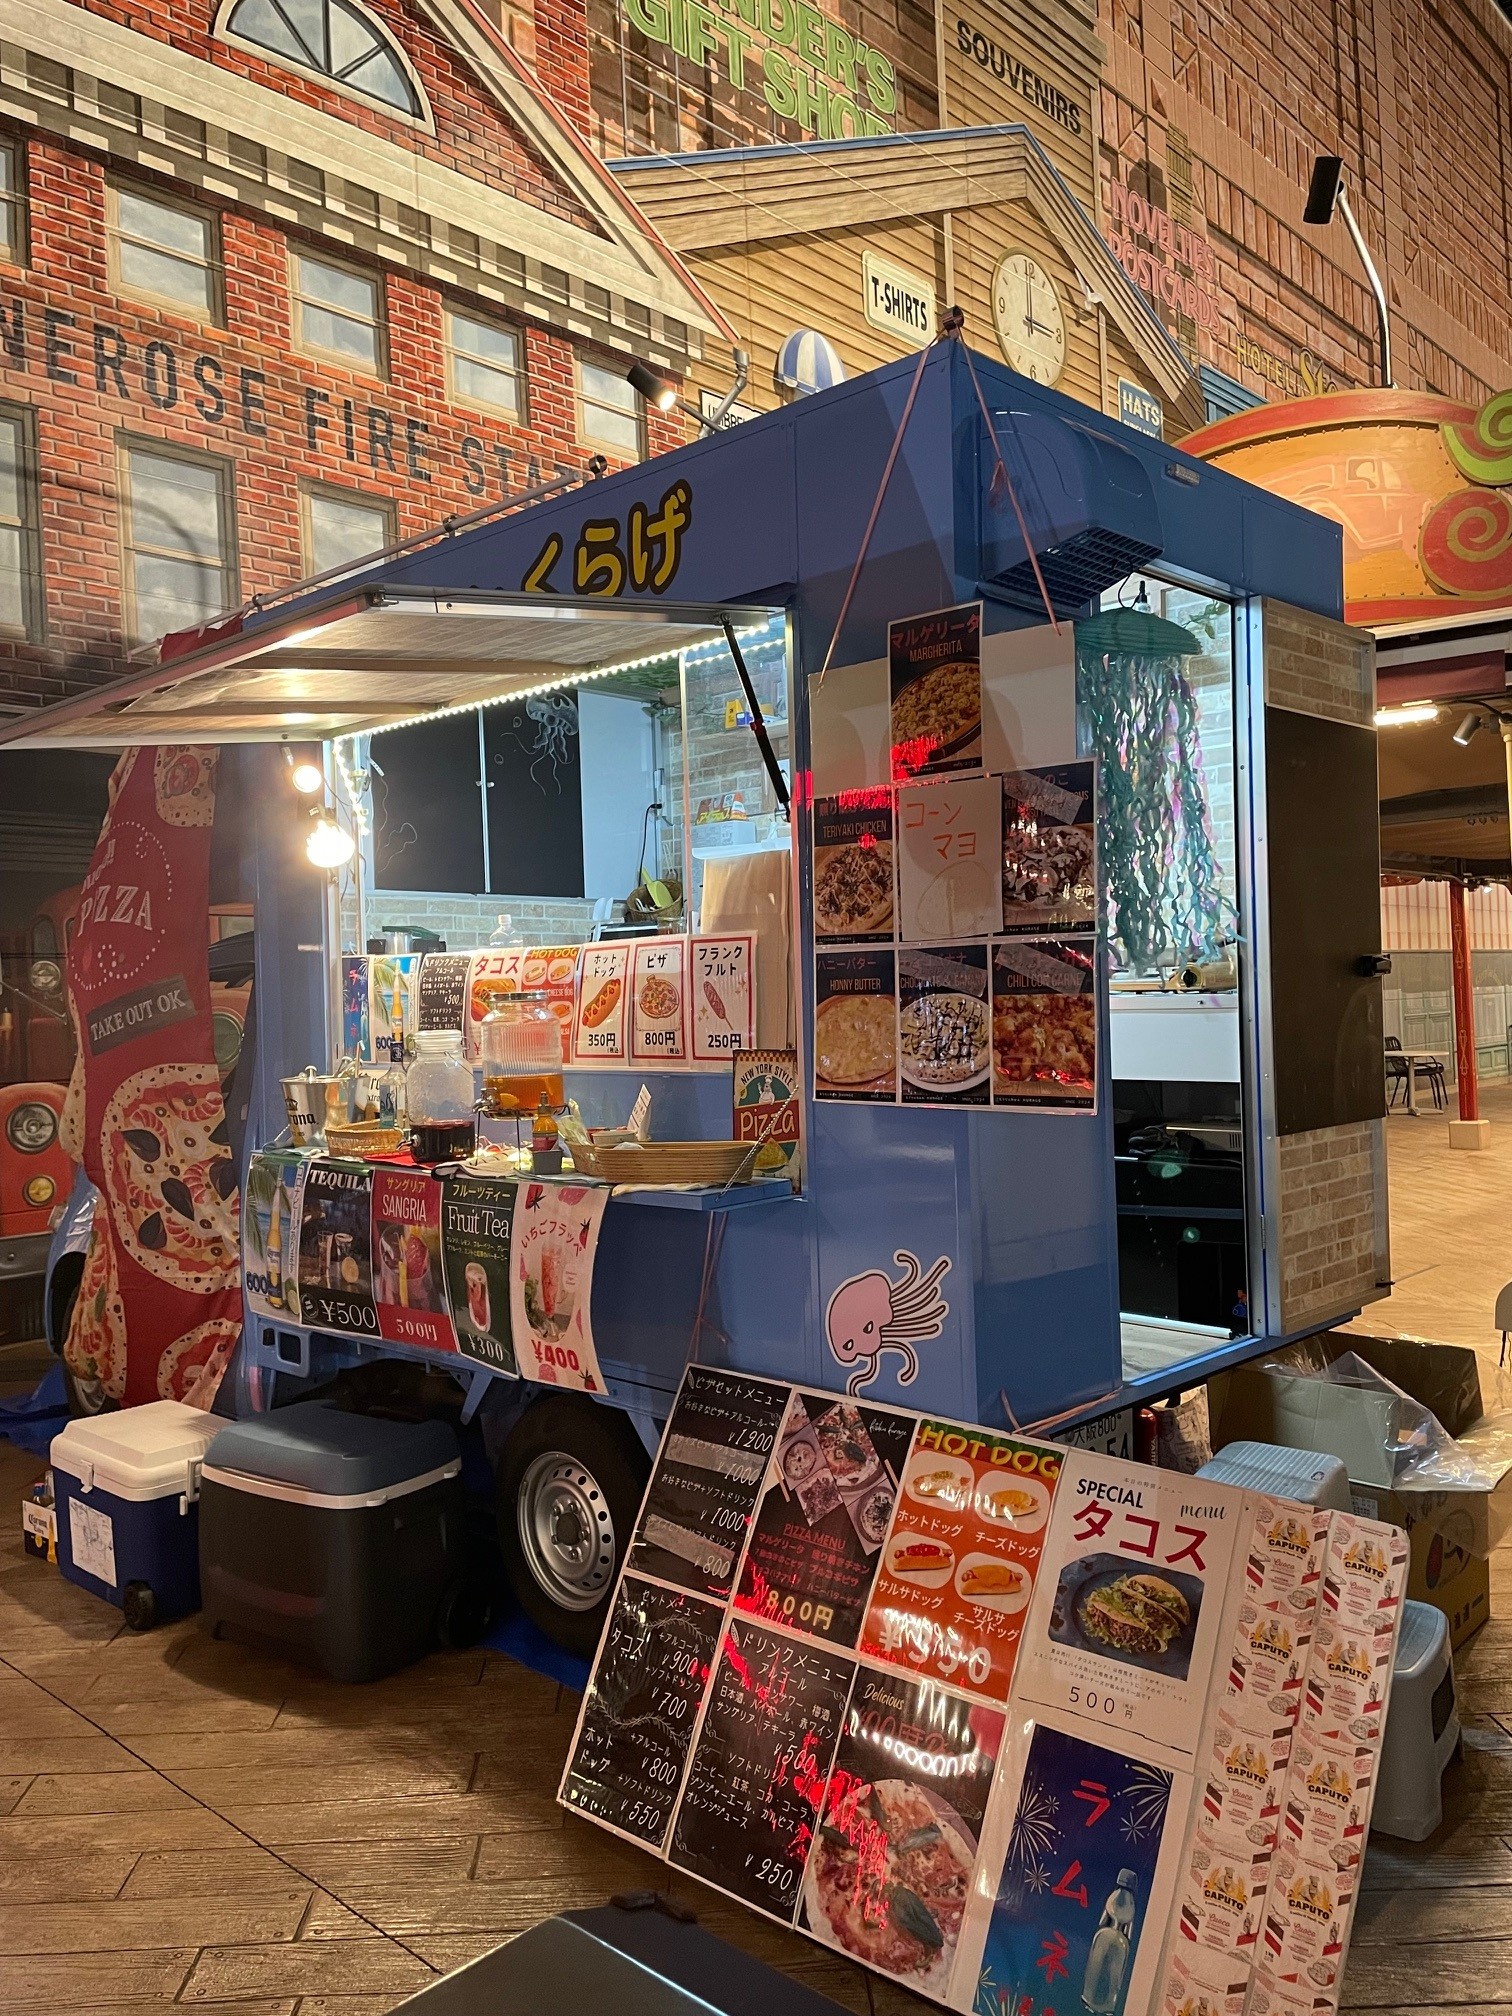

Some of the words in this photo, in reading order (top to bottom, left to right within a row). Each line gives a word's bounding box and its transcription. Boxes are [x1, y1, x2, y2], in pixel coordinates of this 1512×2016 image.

[622, 0, 753, 91] GIFT
[957, 20, 1082, 135] SOUVENIRS
[1111, 176, 1216, 284] NOVELTIES
[1109, 227, 1222, 337] POSTCARDS
[872, 276, 928, 332] T-SHIRTS
[1122, 389, 1160, 427] HATS
[305, 387, 431, 482] FIRE
[521, 479, 692, 598] くらげ
[891, 613, 980, 648] マルゲリータ
[909, 640, 963, 663] MARGHERITA
[823, 823, 854, 838] TERIYAKI
[855, 820, 887, 835] CHICKEN
[905, 803, 963, 829] コーン
[933, 831, 977, 860] マヨ
[475, 956, 520, 977] タコス
[531, 949, 553, 959] HOT
[554, 947, 578, 958] DOG
[594, 953, 617, 965] ホット
[646, 953, 667, 968] ピザ
[699, 946, 742, 961] フランク
[594, 966, 617, 978] ドッグ
[704, 963, 738, 976] フルト
[829, 979, 853, 991] HONNY
[854, 977, 881, 990] BUTTER
[91, 1011, 123, 1041] TAKE
[125, 999, 153, 1026] OUT
[157, 989, 186, 1013] OK
[588, 1033, 616, 1047] 350円
[645, 1031, 676, 1046] 800円
[708, 1033, 742, 1048] 250円
[740, 1067, 754, 1086] NEW
[755, 1063, 772, 1075] YORK
[774, 1065, 793, 1087] STYLE
[309, 1169, 372, 1191] TEQUILA
[386, 1177, 425, 1192] サングリア
[452, 1184, 511, 1203] フルーツティー
[382, 1194, 427, 1222] SANGRIA
[447, 1206, 480, 1234] Fruit
[481, 1210, 510, 1239] Tea
[521, 1220, 582, 1257] いちごフラップ
[319, 1299, 376, 1329] ¥500
[396, 1318, 438, 1342] 500円
[468, 1333, 504, 1362] ¥300
[531, 1339, 579, 1371] ¥400
[695, 1376, 785, 1406] ピザセットメニュー
[728, 1428, 774, 1452] ¥1200
[919, 1425, 986, 1459] HOT
[990, 1449, 1060, 1480] DOG
[1076, 1478, 1144, 1509] SPECIAL
[1180, 1503, 1227, 1520] menu
[700, 1507, 746, 1532] ¥1000
[897, 1510, 964, 1538] ホットドッグ
[784, 1523, 811, 1541] PIZZA
[814, 1531, 846, 1550] MENU
[975, 1531, 1042, 1559] チーズドッグ
[1073, 1499, 1209, 1572] タコス
[1268, 1539, 1307, 1555] CAPUTO
[1345, 1561, 1384, 1578] CAPUTO
[878, 1579, 945, 1610] サルサドッグ
[767, 1590, 835, 1631] 800円
[972, 1605, 1006, 1625] サルサ
[953, 1611, 1021, 1643] チーズドッグ
[611, 1627, 643, 1658] タコス
[742, 1632, 848, 1681] ドリンクメニュー
[1251, 1641, 1289, 1659] CAPUTO
[661, 1650, 699, 1677] ¥900
[1328, 1662, 1369, 1681] CAPUTO
[651, 1687, 687, 1719] ¥700
[863, 1683, 905, 1710] Delicious
[1068, 1685, 1116, 1714] 500
[585, 1726, 613, 1750] ホット
[641, 1757, 678, 1785] ¥800
[1226, 1766, 1266, 1785] CAPUTO
[1308, 1784, 1349, 1804] CAPUTO
[620, 1798, 661, 1830] ¥550
[685, 1791, 748, 1830] オレンジジュース
[745, 1853, 793, 1890] ¥250
[1038, 1779, 1111, 1983] ラムネ
[1204, 1889, 1244, 1911] CAPUTO
[1289, 1899, 1330, 1920] CAPUTO
